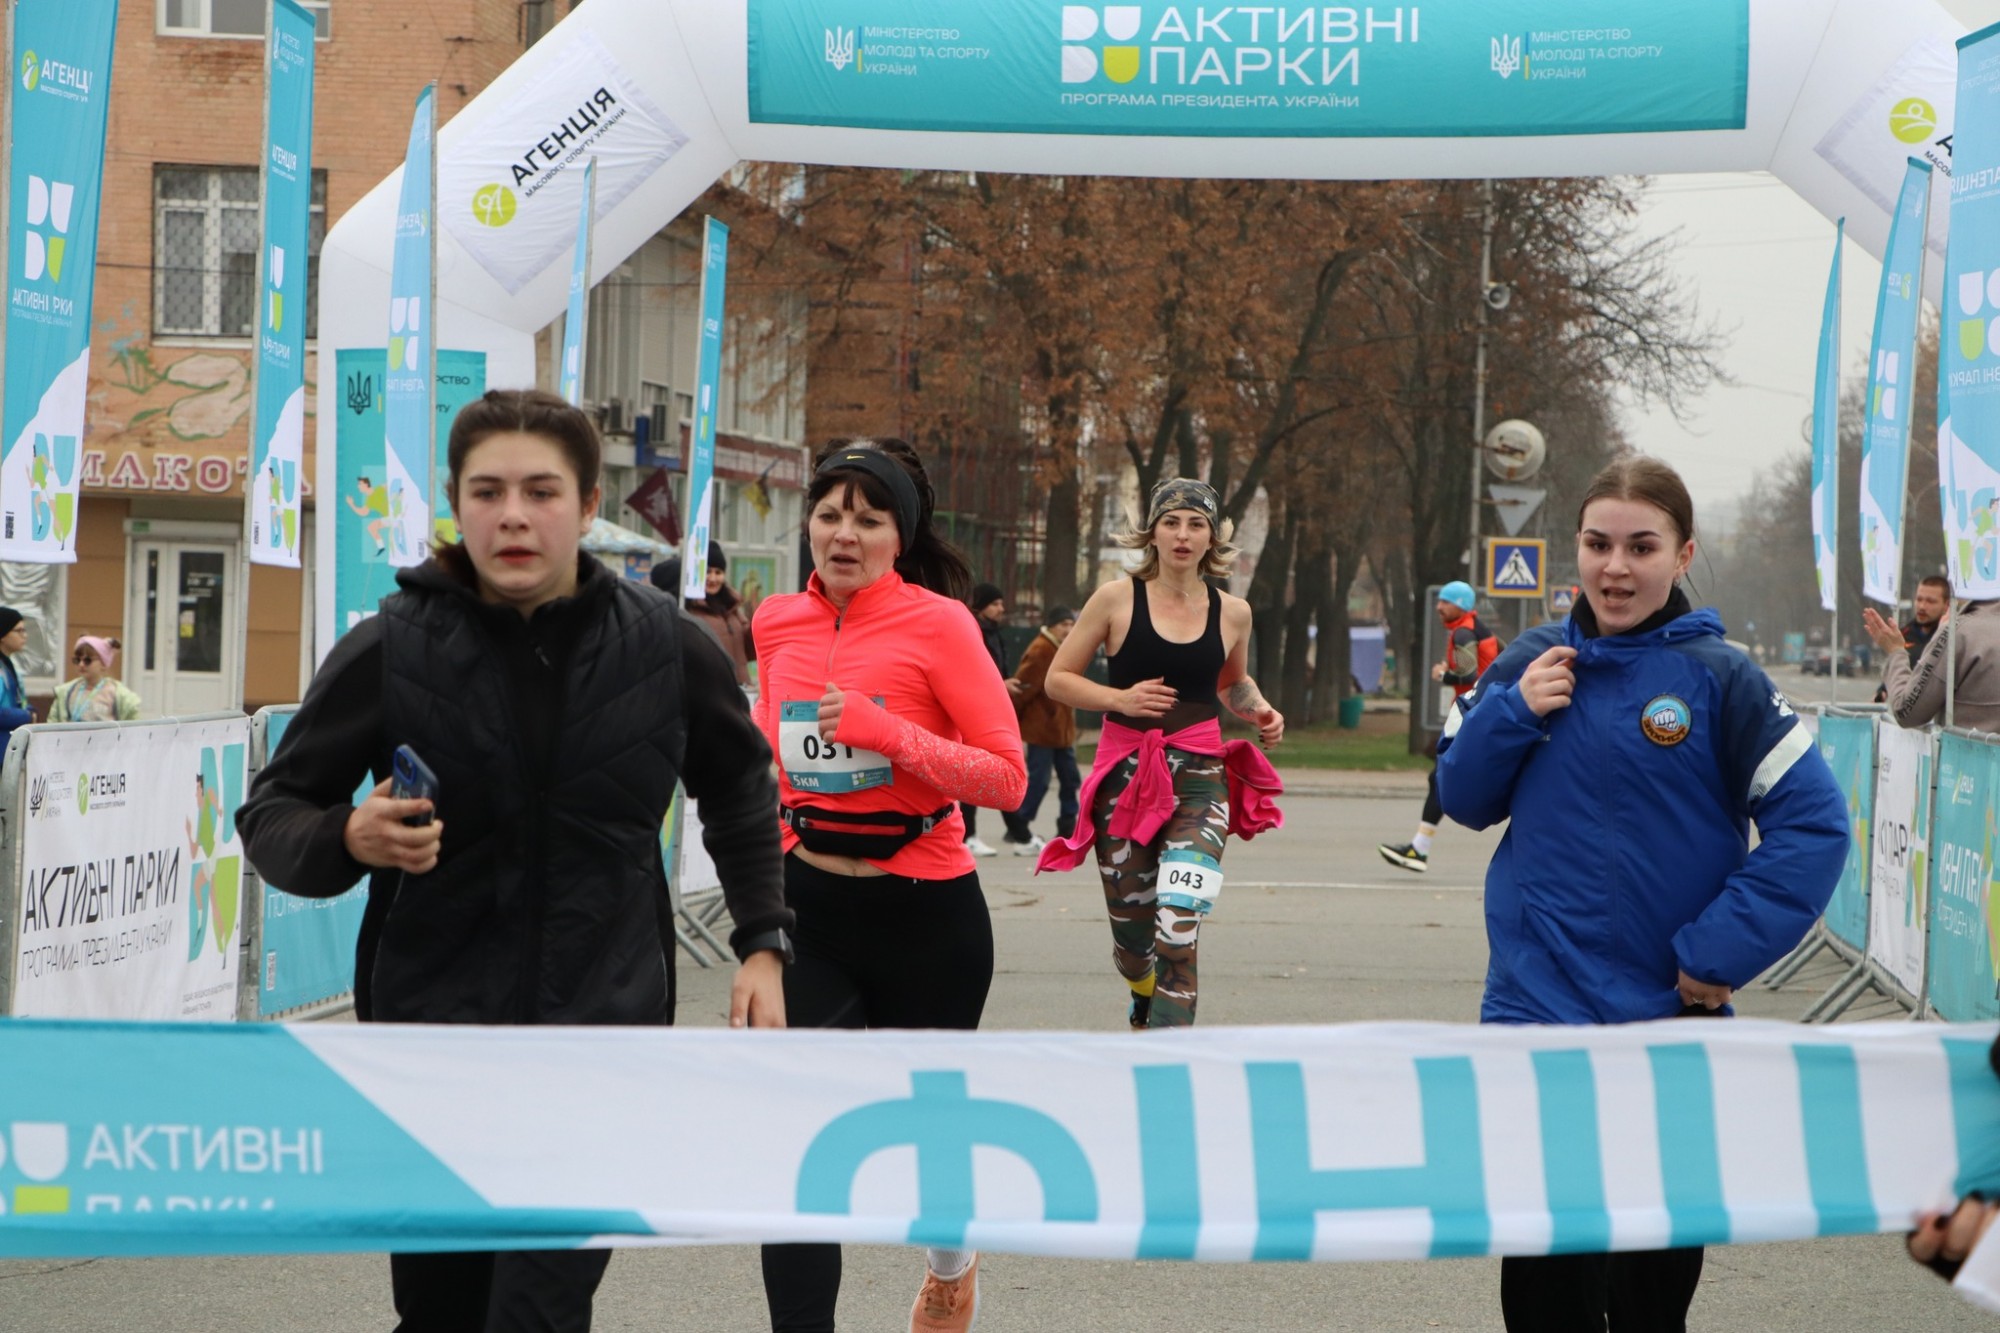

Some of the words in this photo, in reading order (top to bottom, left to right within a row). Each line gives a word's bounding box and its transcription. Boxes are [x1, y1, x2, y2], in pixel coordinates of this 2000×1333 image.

[864, 26, 960, 40] МІНІСТЕРСТВО
[1150, 7, 1419, 43] АКТИВНІ
[1531, 28, 1632, 43] МІНІСТЕРСТВО
[864, 44, 917, 59] МОЛОДІ
[918, 46, 935, 59] ТА
[937, 47, 990, 60] СПОРТУ
[1531, 48, 1586, 62] МОЛОДІ
[1588, 47, 1606, 60] ТА
[1608, 46, 1663, 59] СПОРТУ
[41, 59, 93, 94] АГЕНЦІ
[864, 63, 917, 76] УКРАЇНИ
[1150, 46, 1359, 85] ПАРКИ
[1531, 67, 1586, 81] УКРАЇНИ
[1061, 93, 1157, 106] ПРОГРАМА
[1162, 94, 1279, 108] ПРЕЗИДЕНТА
[1284, 94, 1360, 108] УКРАЇНИ
[511, 87, 616, 187] АГЕНЦІЯ
[525, 162, 566, 198] МАСОВОГО
[565, 136, 595, 164] СПОРТУ
[594, 108, 627, 138] УКРАЇНИ
[12, 288, 49, 312] АКТИВНІ
[89, 773, 126, 797] АГЕНЦІЯ
[23, 858, 115, 934] АКТИВНІ
[121, 847, 180, 916] ПАРКИ
[1169, 870, 1204, 889] 043
[83, 1123, 323, 1175] АКТИВНІ
